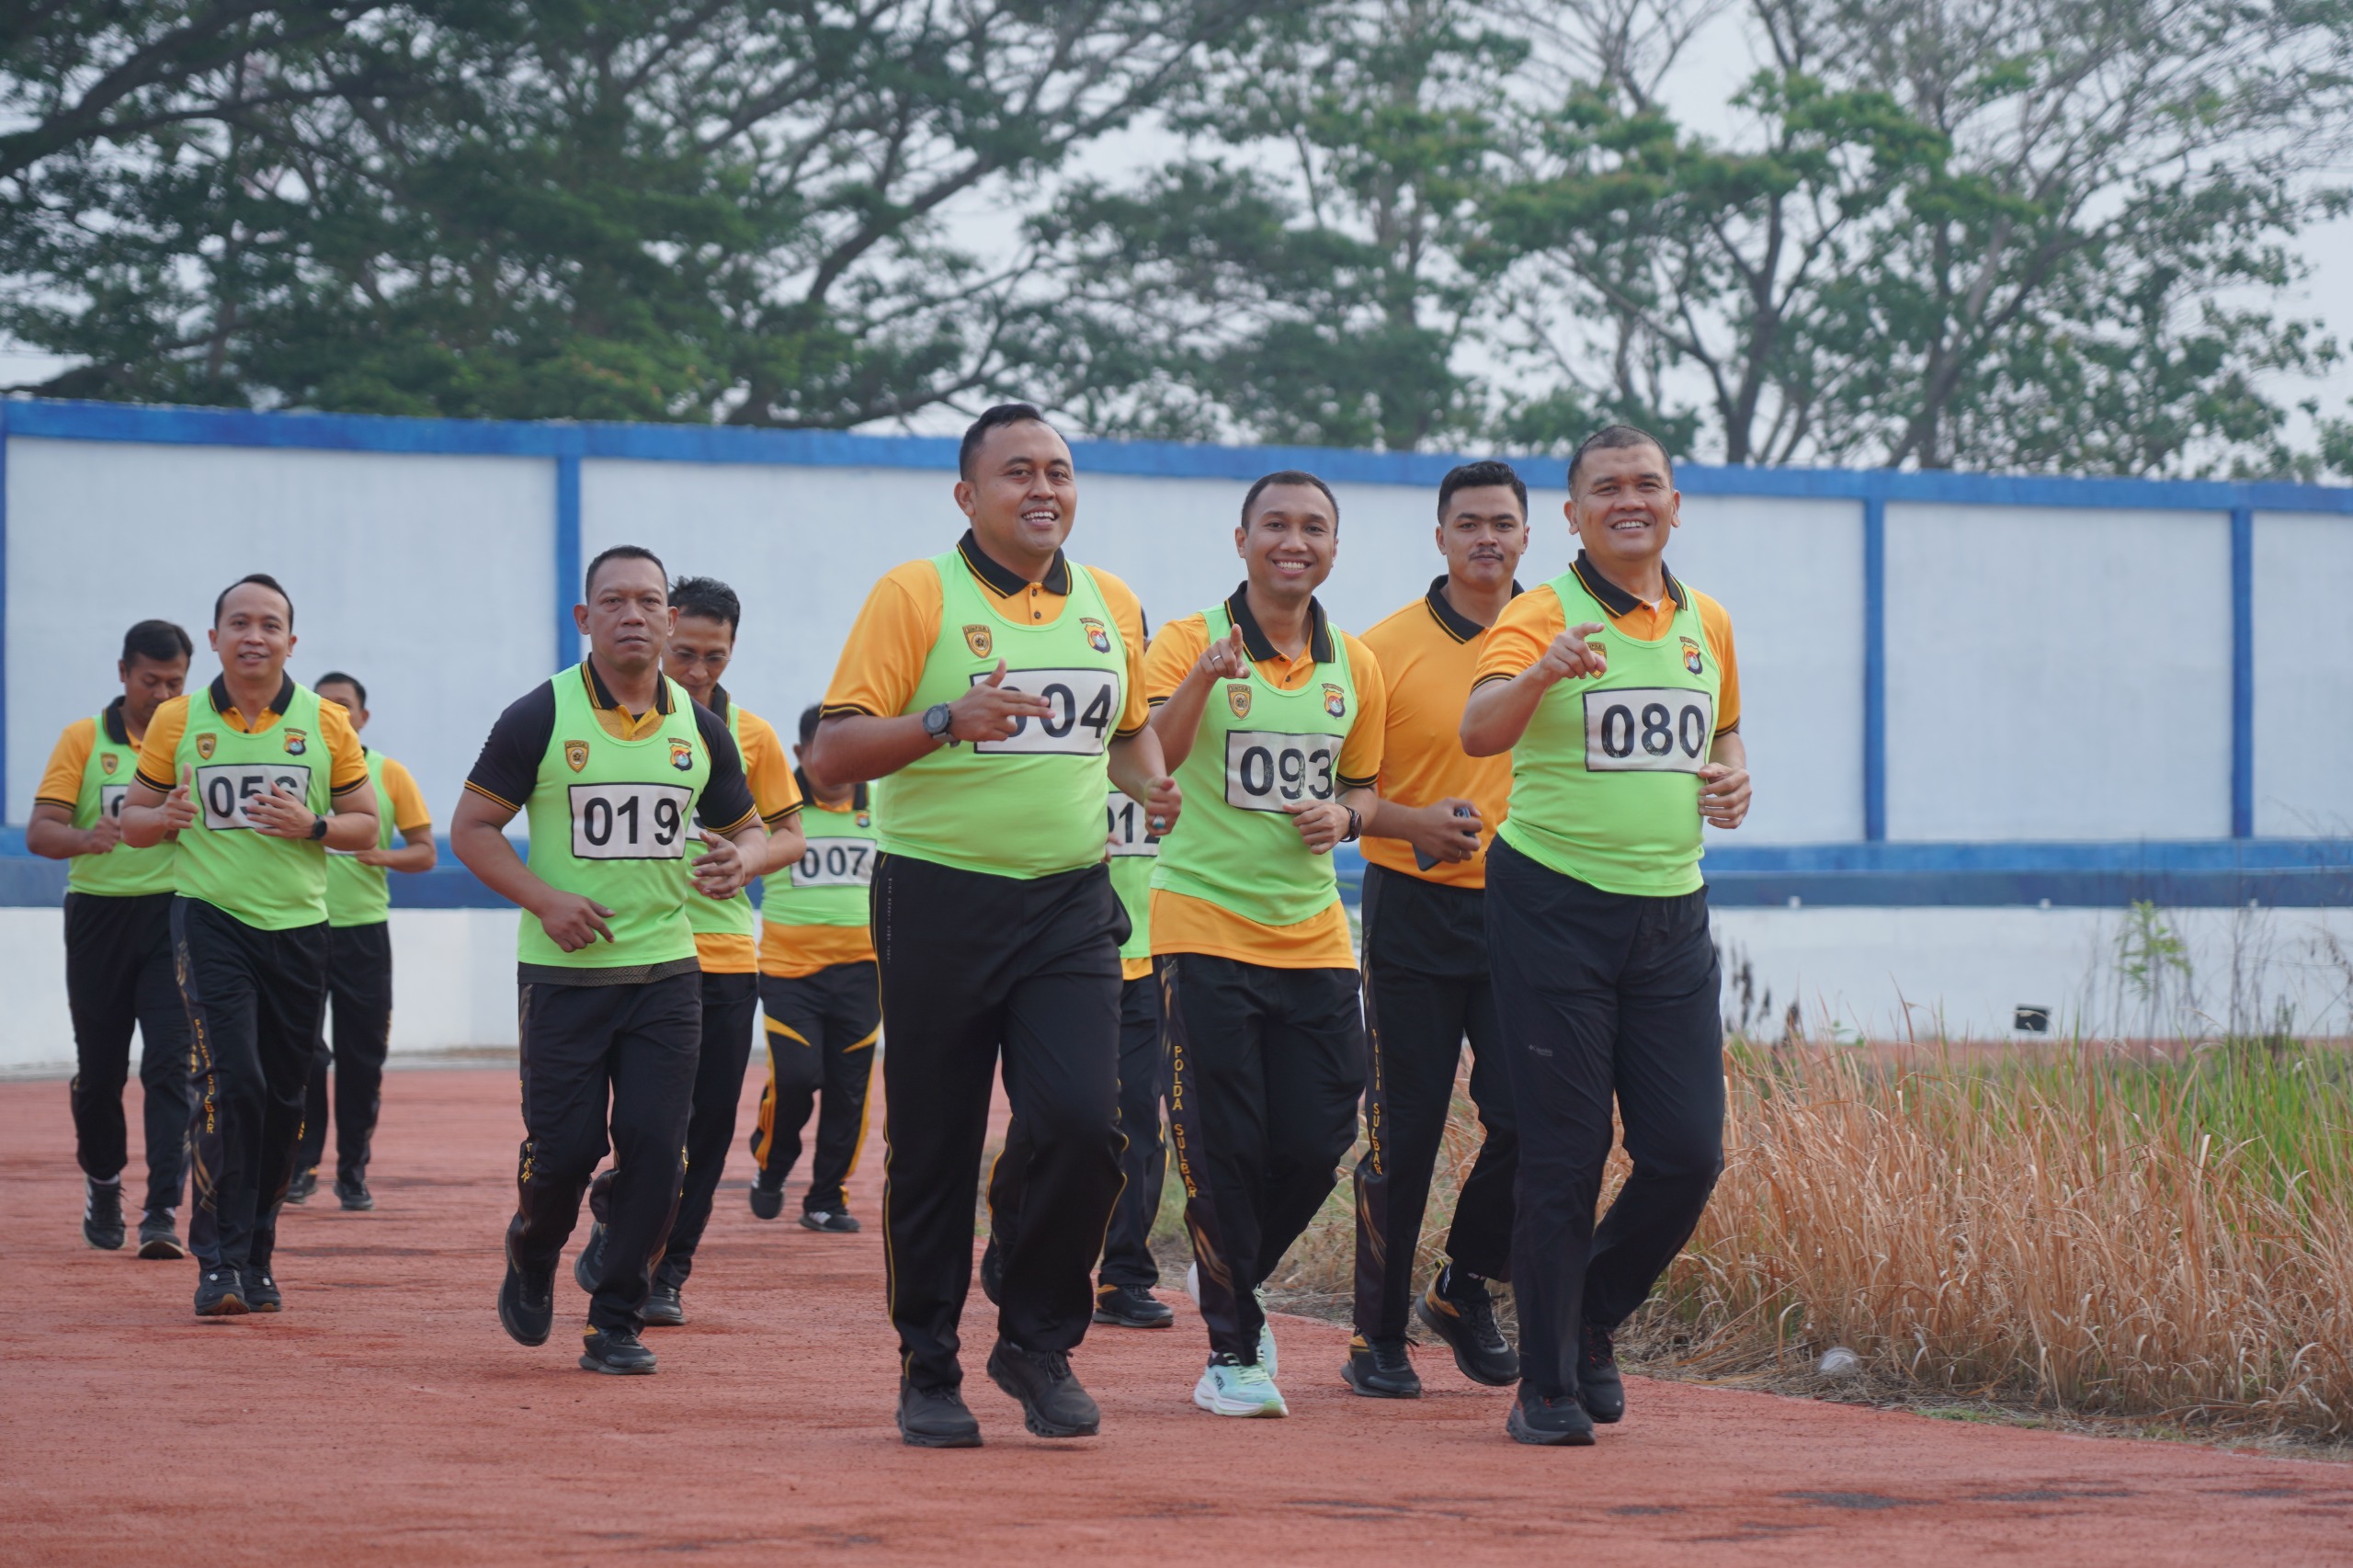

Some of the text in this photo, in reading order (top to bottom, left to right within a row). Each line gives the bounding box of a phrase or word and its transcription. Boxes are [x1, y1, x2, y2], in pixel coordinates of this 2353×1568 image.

[1601, 703, 1705, 758] 080
[1240, 745, 1334, 800] 093
[584, 796, 680, 846] 019
[800, 846, 869, 878] 007
[204, 1074, 215, 1134] SULBAR
[1172, 1045, 1198, 1198] POLDA SULBAR
[1370, 1102, 1382, 1176] SULBAR
